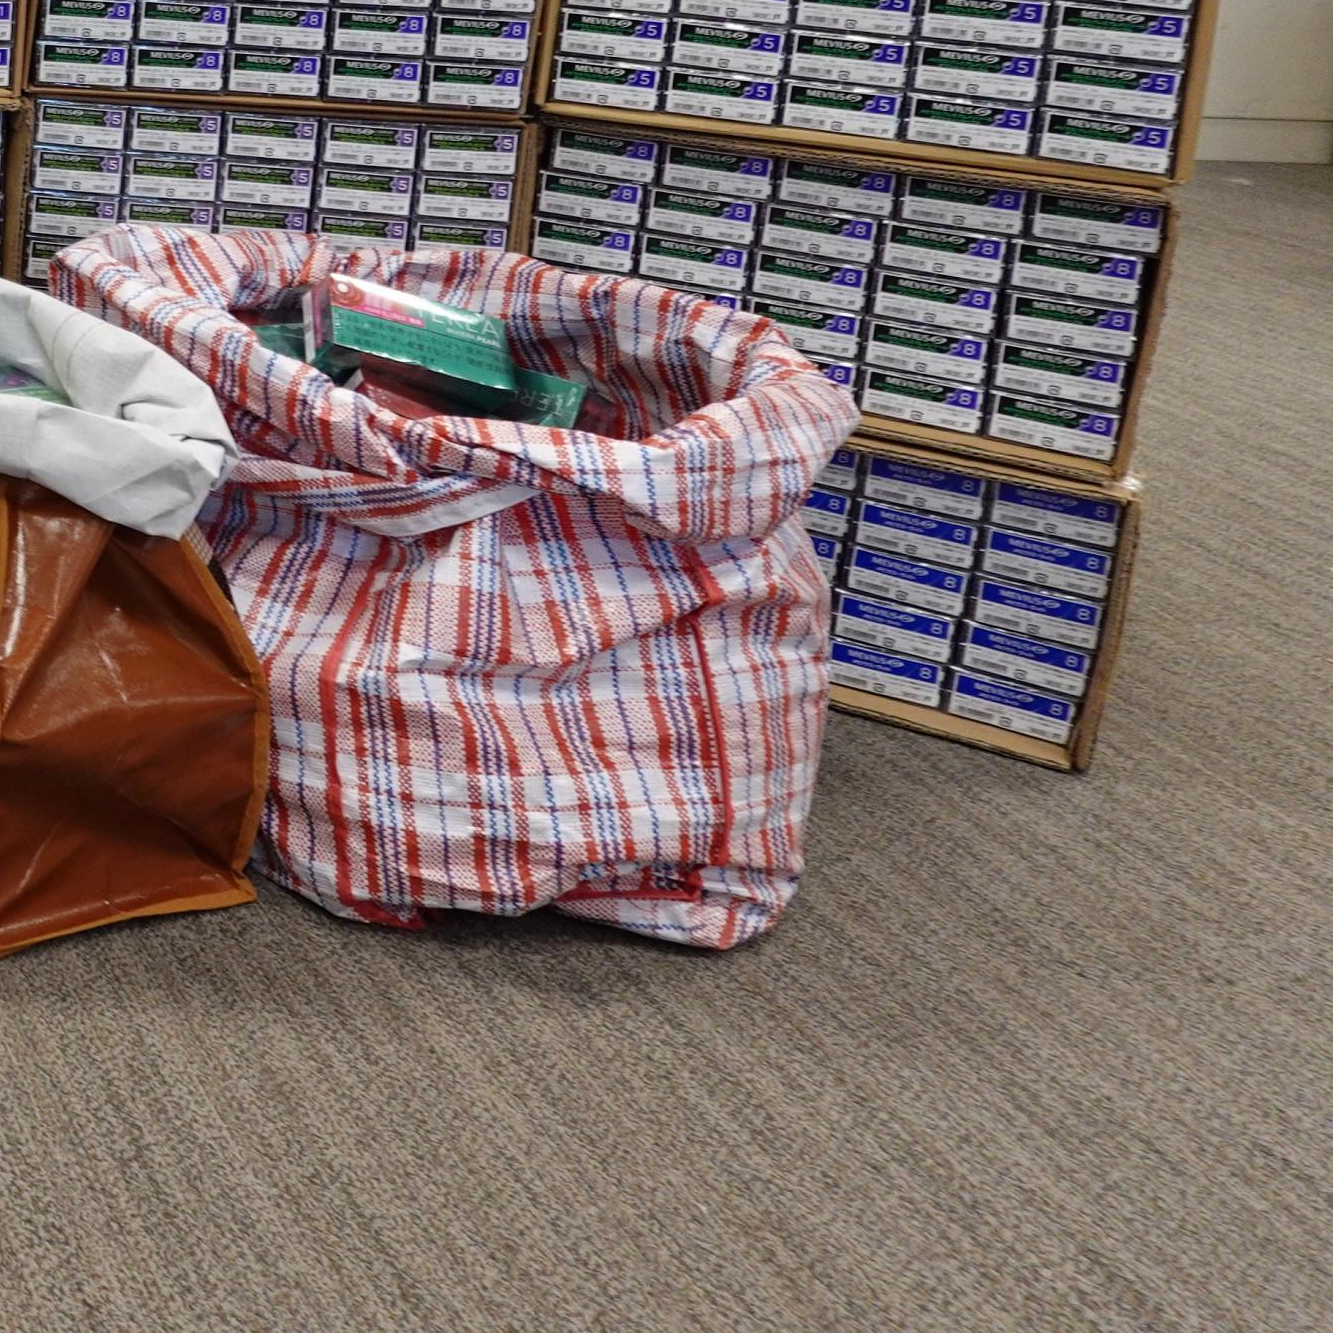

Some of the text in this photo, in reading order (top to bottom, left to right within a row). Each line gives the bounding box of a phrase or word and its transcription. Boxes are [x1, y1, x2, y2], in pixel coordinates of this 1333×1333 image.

[1081, 9, 1176, 33] MEVIUS 5
[55, 47, 121, 63] MEVIUS 8
[247, 56, 313, 73] MEVIUS 8
[446, 67, 515, 84] MEVIUS 8
[111, 114, 121, 125] 5
[303, 126, 313, 137] 5
[402, 133, 412, 144] 5
[559, 177, 633, 201] MEVIUS 8
[668, 194, 747, 219] MEVIUS 8
[906, 228, 995, 255] MEVIUS 8
[1036, 248, 1130, 275] MEVIUS 8
[952, 528, 966, 541] 8
[1086, 557, 1100, 570] 8
[944, 576, 958, 590] 8
[1077, 608, 1091, 621] 8
